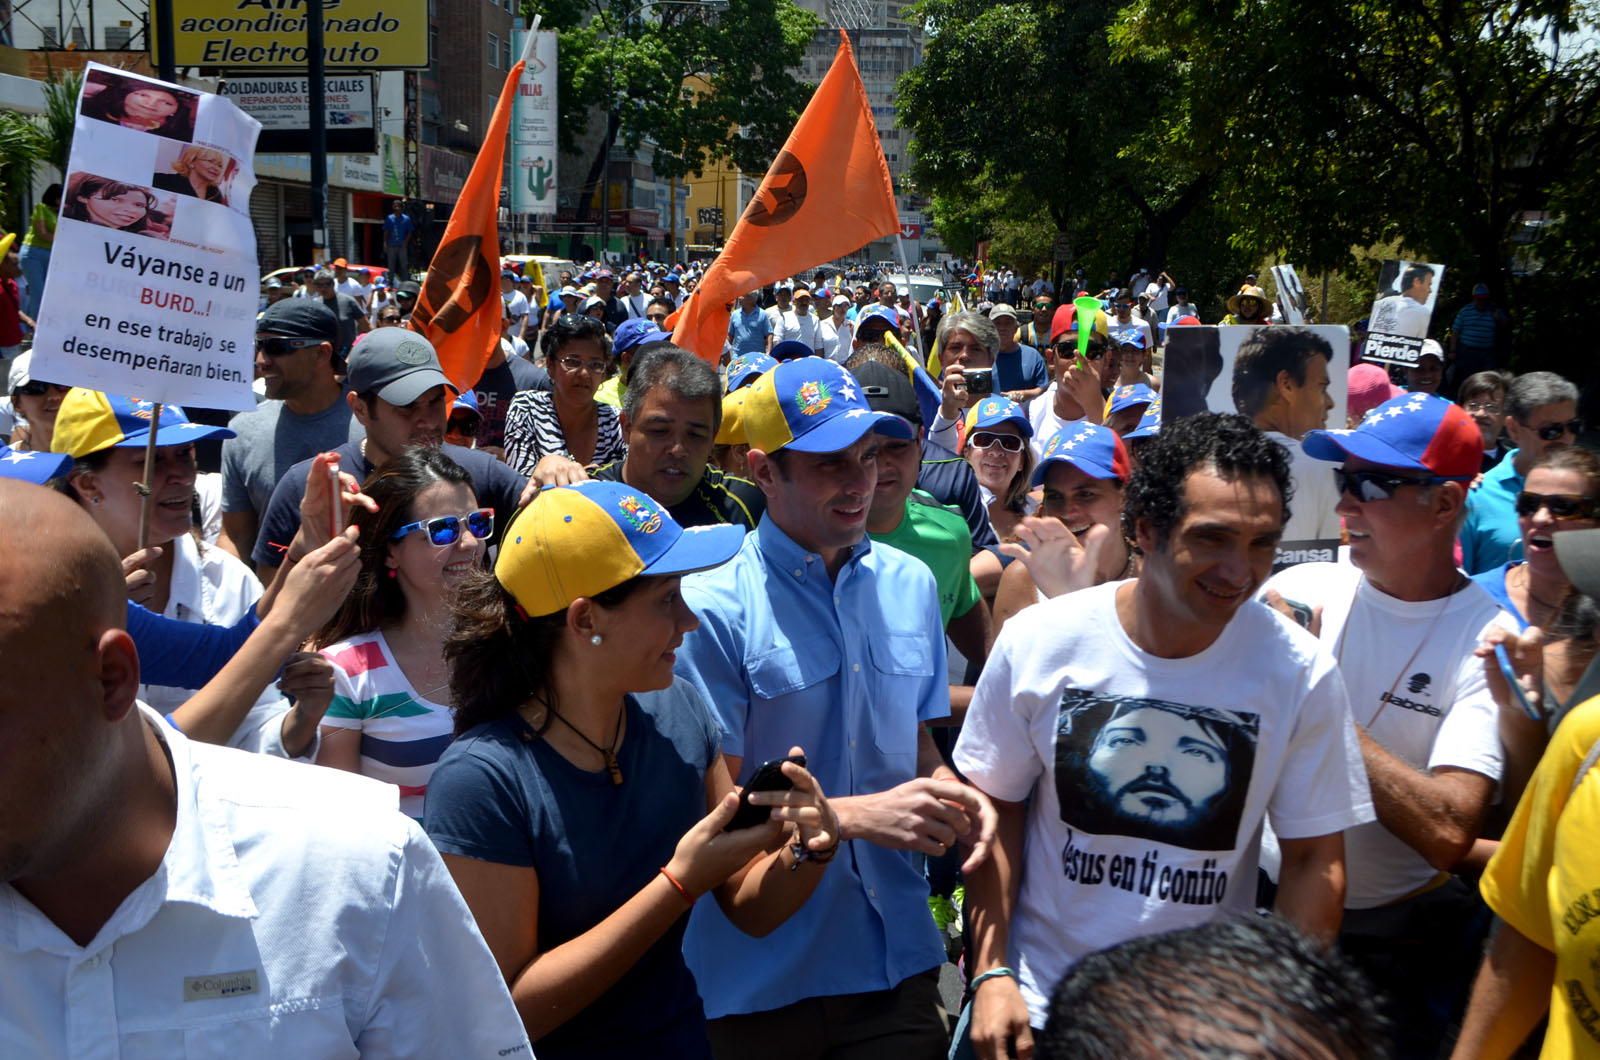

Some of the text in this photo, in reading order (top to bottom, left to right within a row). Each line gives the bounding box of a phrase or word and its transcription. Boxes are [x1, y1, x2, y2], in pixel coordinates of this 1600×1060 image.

[180, 11, 399, 32] acondicinado
[202, 39, 380, 62] Electrouto
[223, 80, 364, 95] SOLDADURAS EECIALES
[240, 95, 302, 105] REPARACIÓN
[104, 242, 204, 283] Váyanse
[208, 270, 218, 287] a
[224, 274, 246, 293] un
[85, 313, 236, 353] en ese trabajo se
[63, 336, 247, 384] desempeñaran bien.
[1364, 340, 1419, 362] Pierde
[1062, 827, 1106, 885] Jesus
[1109, 854, 1136, 892] en
[1139, 849, 1158, 897] ti
